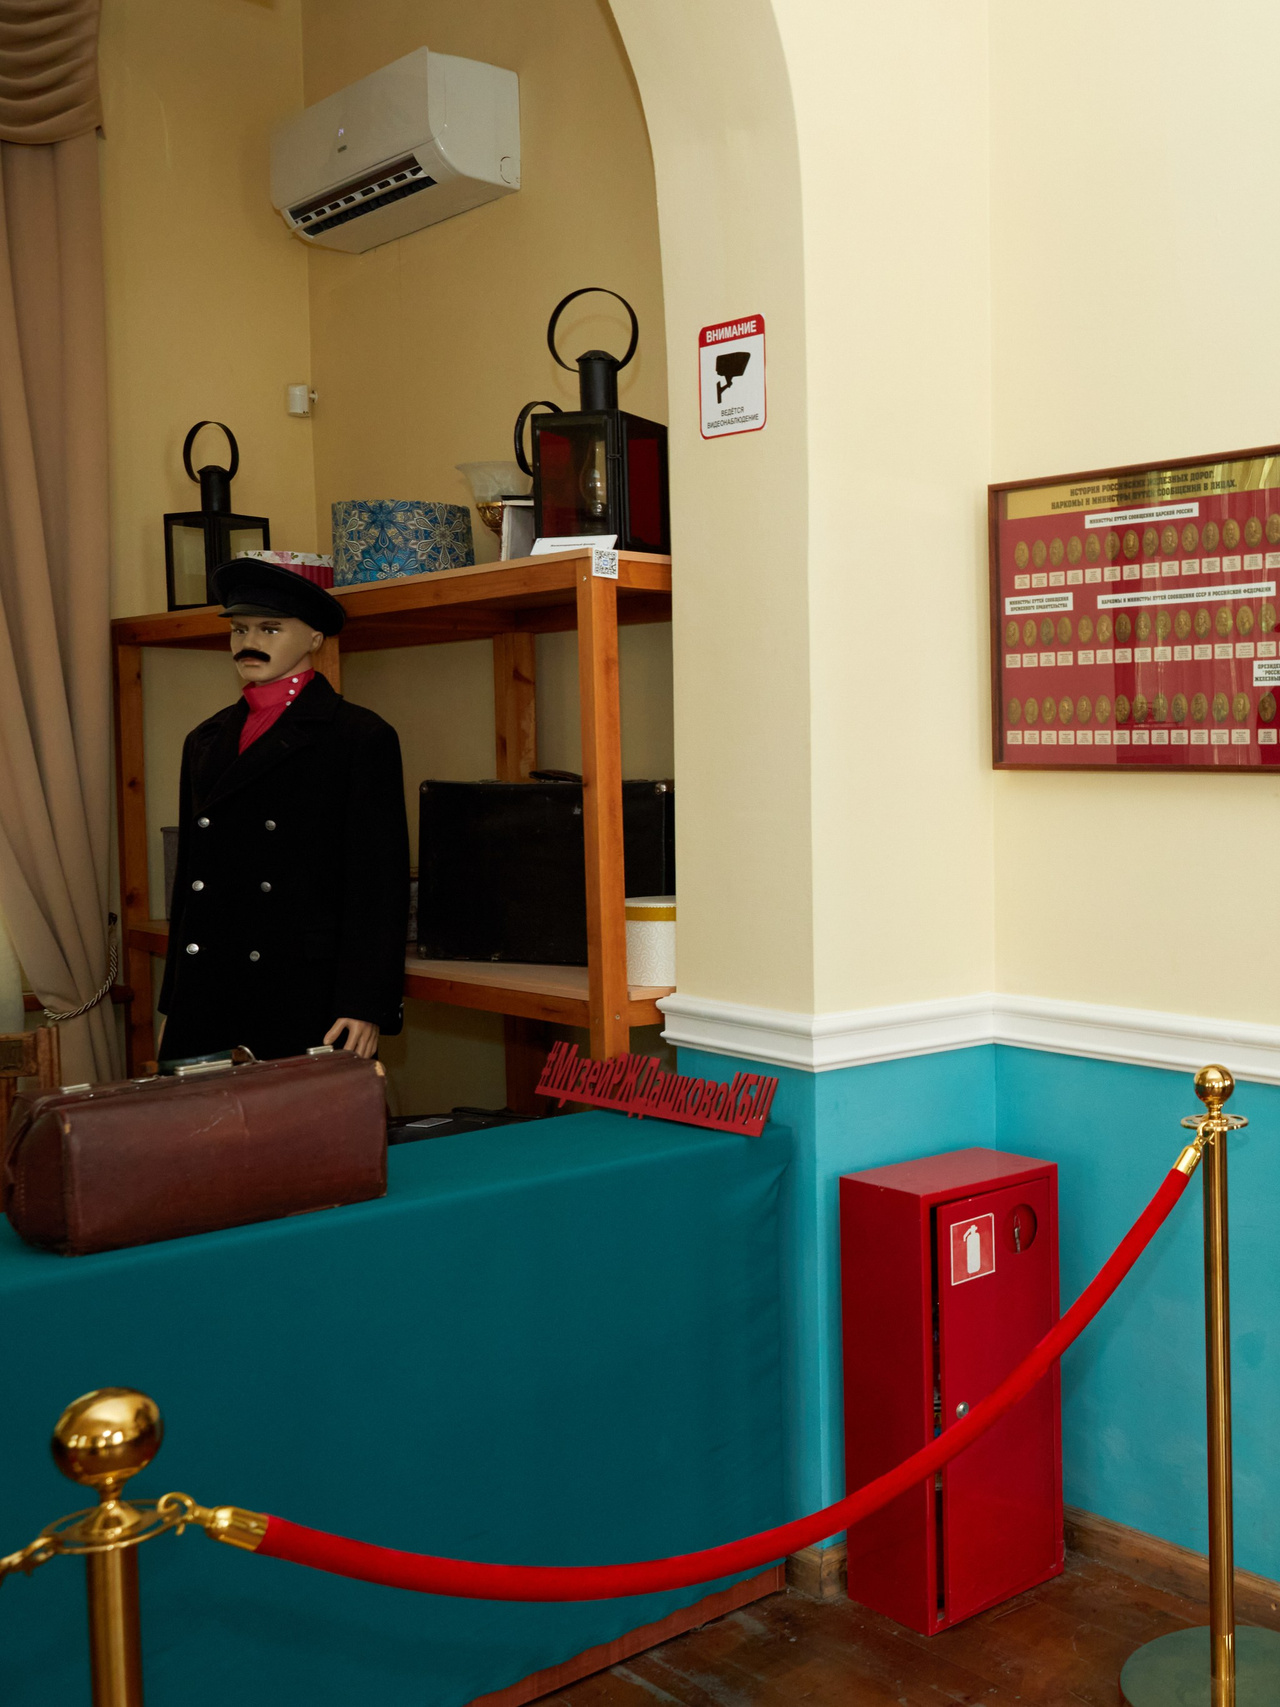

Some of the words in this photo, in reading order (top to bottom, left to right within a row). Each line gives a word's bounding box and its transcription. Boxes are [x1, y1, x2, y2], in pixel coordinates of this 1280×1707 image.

[706, 320, 757, 343] ВНИМАНИЕ
[707, 413, 759, 429] ВИДЕОНАБЛЮДЕНИЕ
[720, 406, 745, 417] ВЕДЁТСЯ
[1070, 485, 1100, 496] ИСТОРИЯ
[1190, 470, 1214, 481] ДОРОГ.
[1051, 497, 1083, 510] НАРКОМЫ
[1085, 497, 1090, 506] И
[1092, 491, 1131, 505] МИНИСТРЫ
[1157, 482, 1201, 496] СООБЩЕНИЯ
[1203, 481, 1209, 491] В
